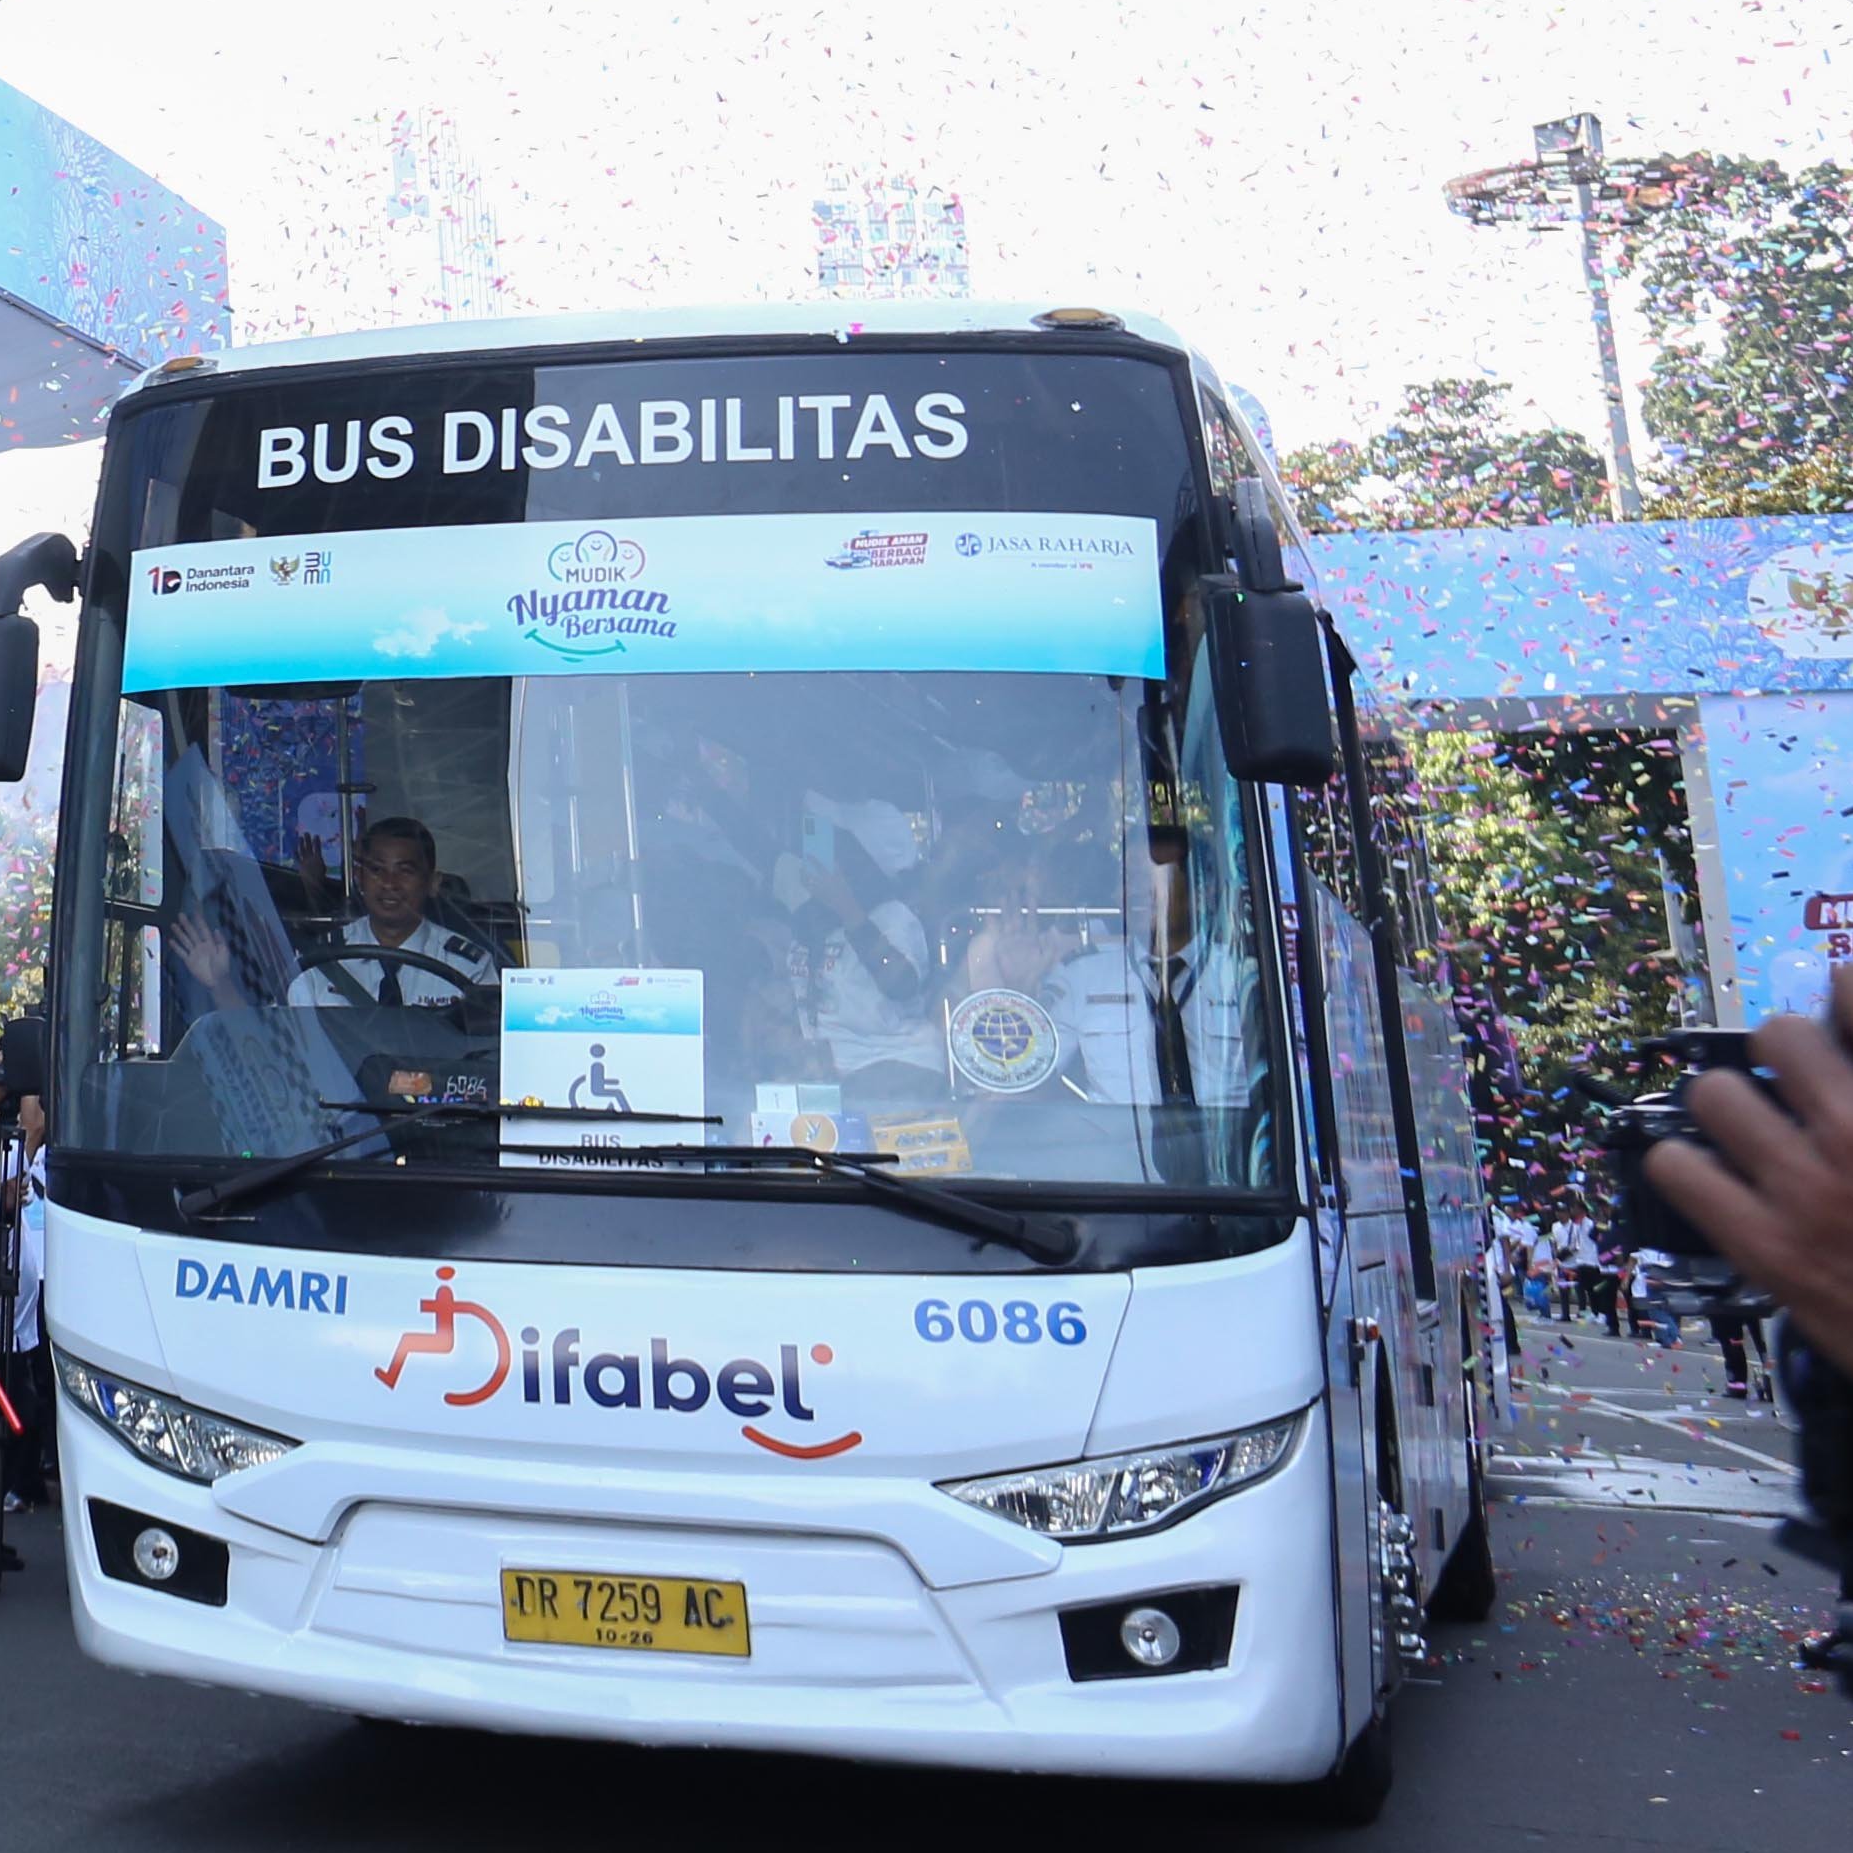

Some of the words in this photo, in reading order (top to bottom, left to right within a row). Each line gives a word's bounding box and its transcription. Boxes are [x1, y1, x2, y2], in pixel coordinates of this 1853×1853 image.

[256, 414, 416, 489] BUS
[441, 391, 970, 476] DISABILITAS
[871, 546, 926, 559] BERBAGI
[987, 536, 1033, 553] JASA
[1039, 536, 1135, 556] RAHARJA
[186, 563, 255, 580] Danantara
[870, 556, 924, 568] HARAPAN
[186, 577, 250, 594] Indonesia
[566, 566, 626, 584] MUDIK
[507, 588, 671, 626] Nyaman
[560, 614, 677, 639] Bersama
[174, 1256, 350, 1318] DAMRI
[914, 1296, 1089, 1346] 6086
[515, 1576, 558, 1619] DR
[573, 1579, 662, 1625] 7259
[684, 1585, 726, 1629] AC
